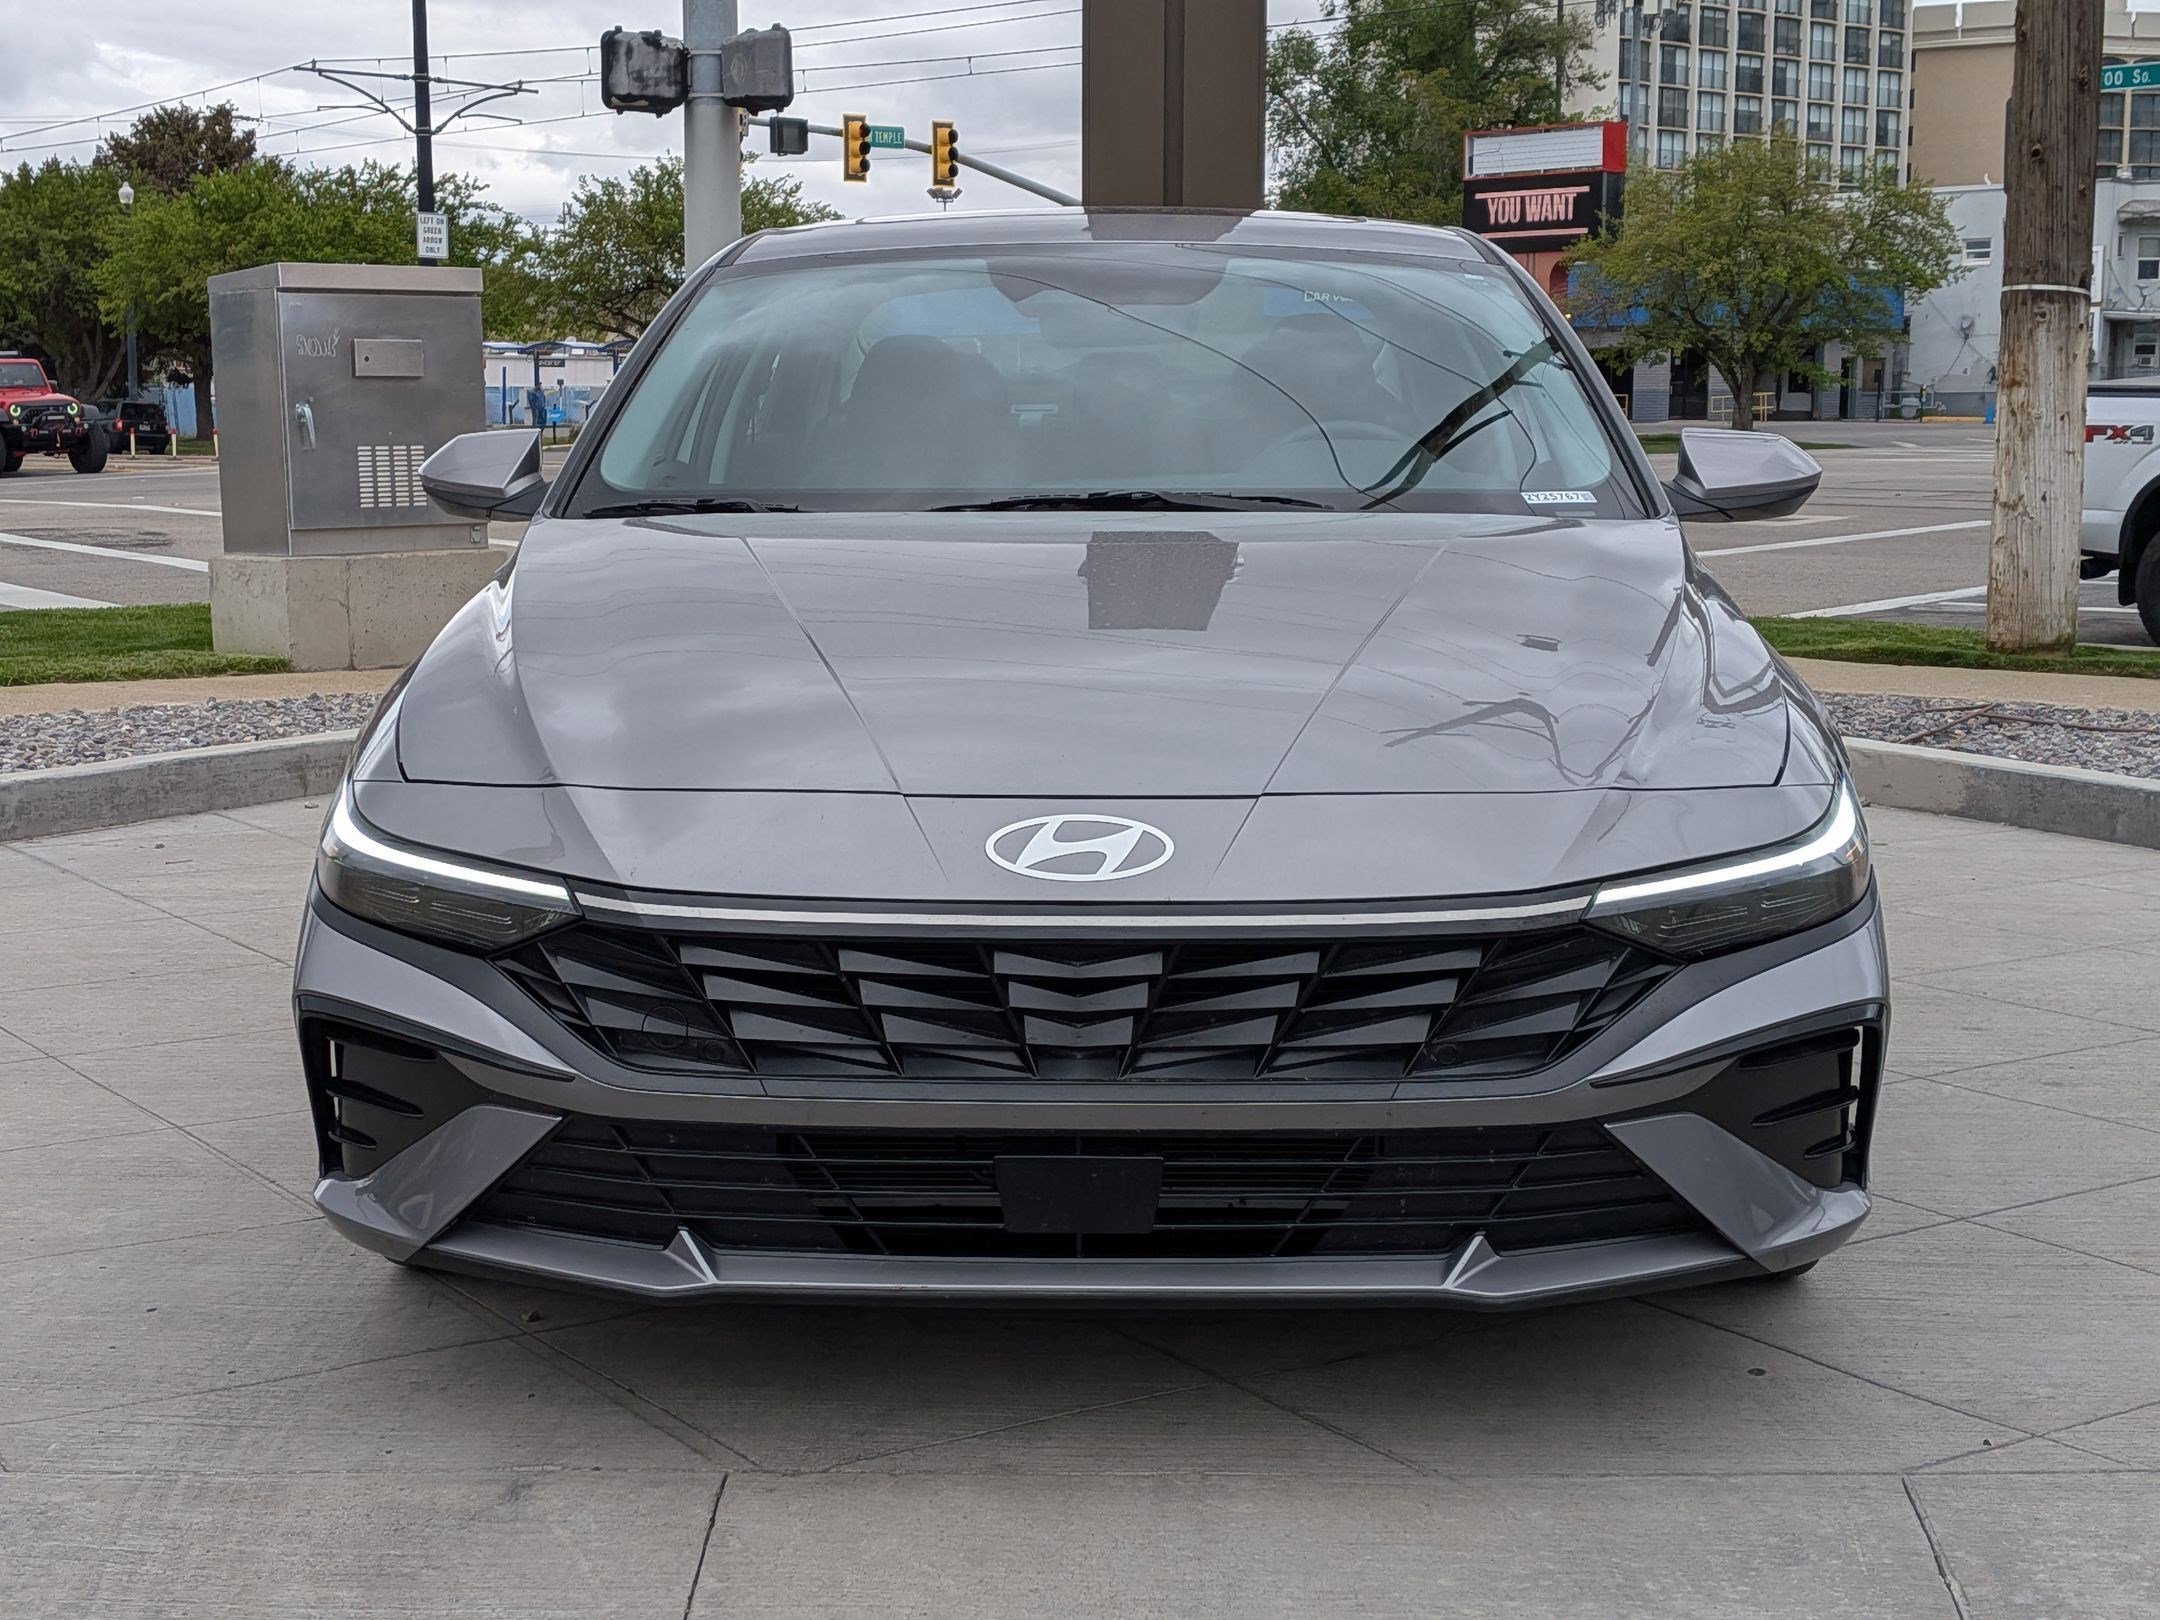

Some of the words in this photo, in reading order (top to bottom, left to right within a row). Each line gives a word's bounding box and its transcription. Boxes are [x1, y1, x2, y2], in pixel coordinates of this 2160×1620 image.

[2103, 70, 2123, 86] 00
[875, 130, 903, 144] TEMPLE
[1487, 196, 1520, 225] YOU
[1525, 193, 1577, 222] WANT
[420, 216, 434, 225] LEFT
[423, 226, 442, 235] GREEN
[423, 236, 442, 244] ARROW
[425, 245, 441, 254] ONLY
[2085, 425, 2154, 442] FX4
